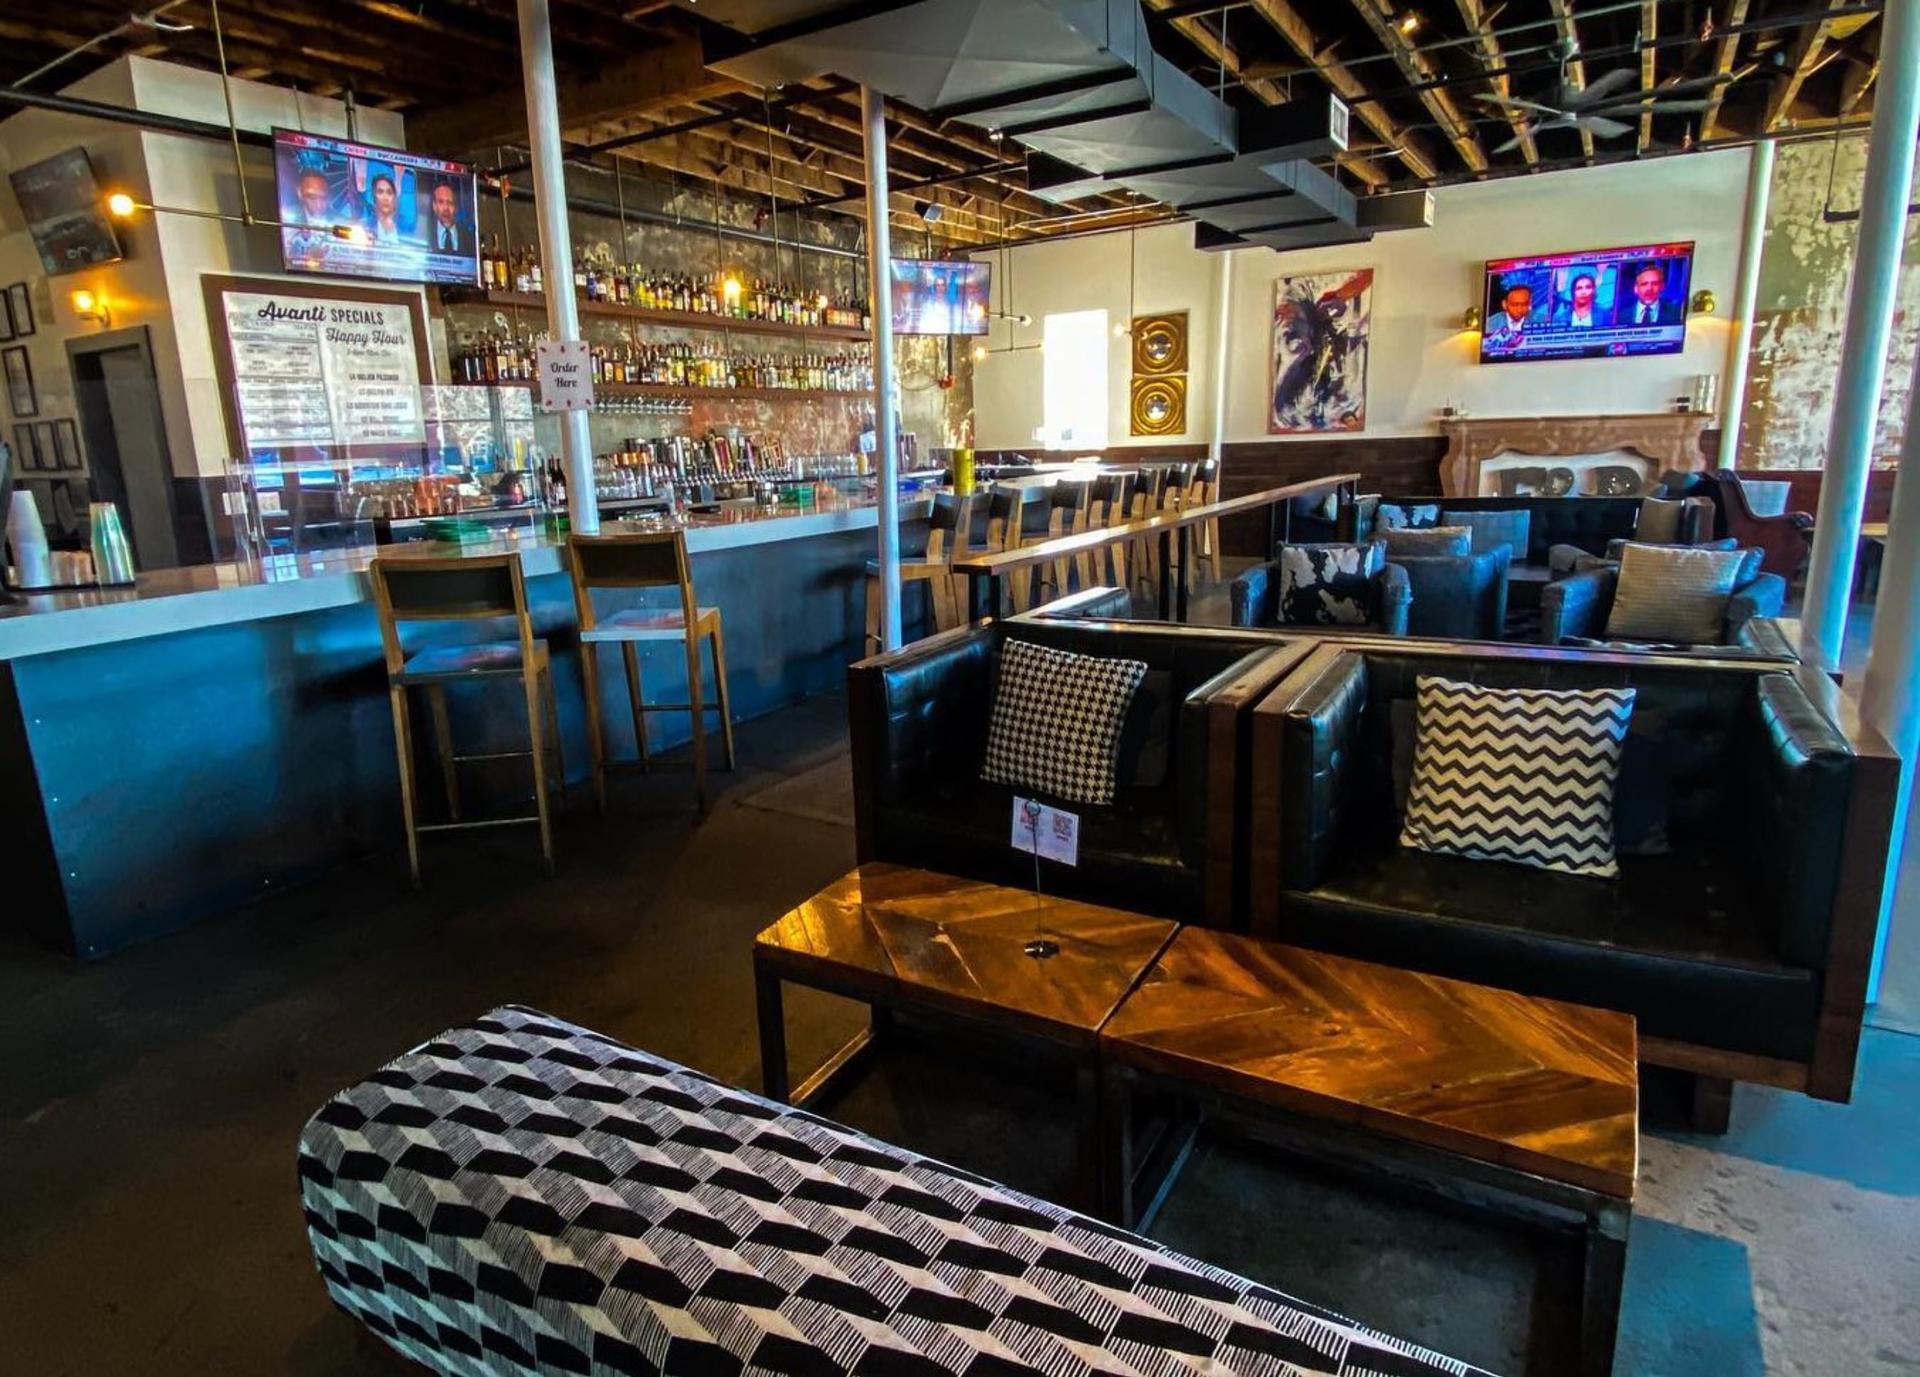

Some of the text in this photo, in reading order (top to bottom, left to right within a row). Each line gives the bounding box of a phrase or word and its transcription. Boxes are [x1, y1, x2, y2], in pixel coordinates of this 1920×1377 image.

[258, 301, 384, 325] Avanti SPECIALS
[326, 328, 369, 346] Happy
[371, 330, 404, 345] Hour
[550, 361, 579, 373] Order
[554, 377, 578, 388] Here
